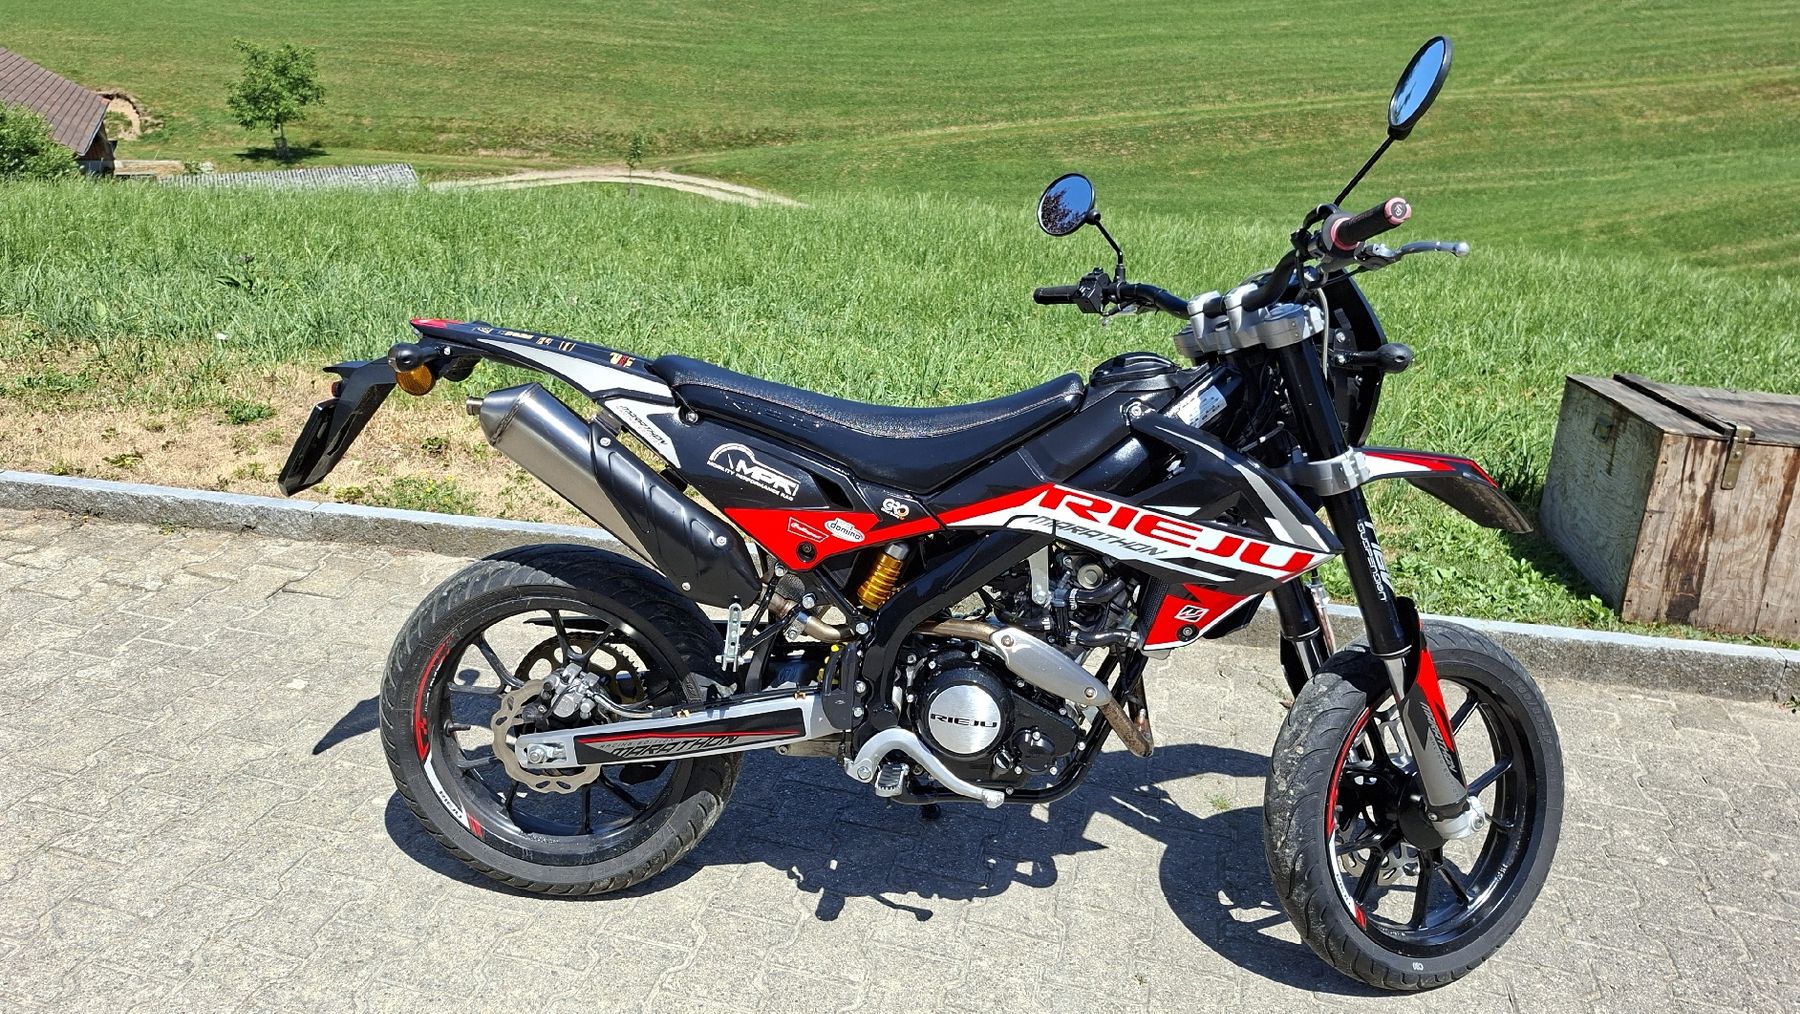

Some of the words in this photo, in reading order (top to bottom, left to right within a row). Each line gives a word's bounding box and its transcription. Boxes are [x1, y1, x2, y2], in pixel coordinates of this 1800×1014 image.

[830, 522, 861, 541] domino
[1029, 515, 1168, 556] MARATHON
[1039, 488, 1314, 572] RIEJU
[930, 713, 998, 728] RIEJU
[612, 736, 740, 757] MARATHON
